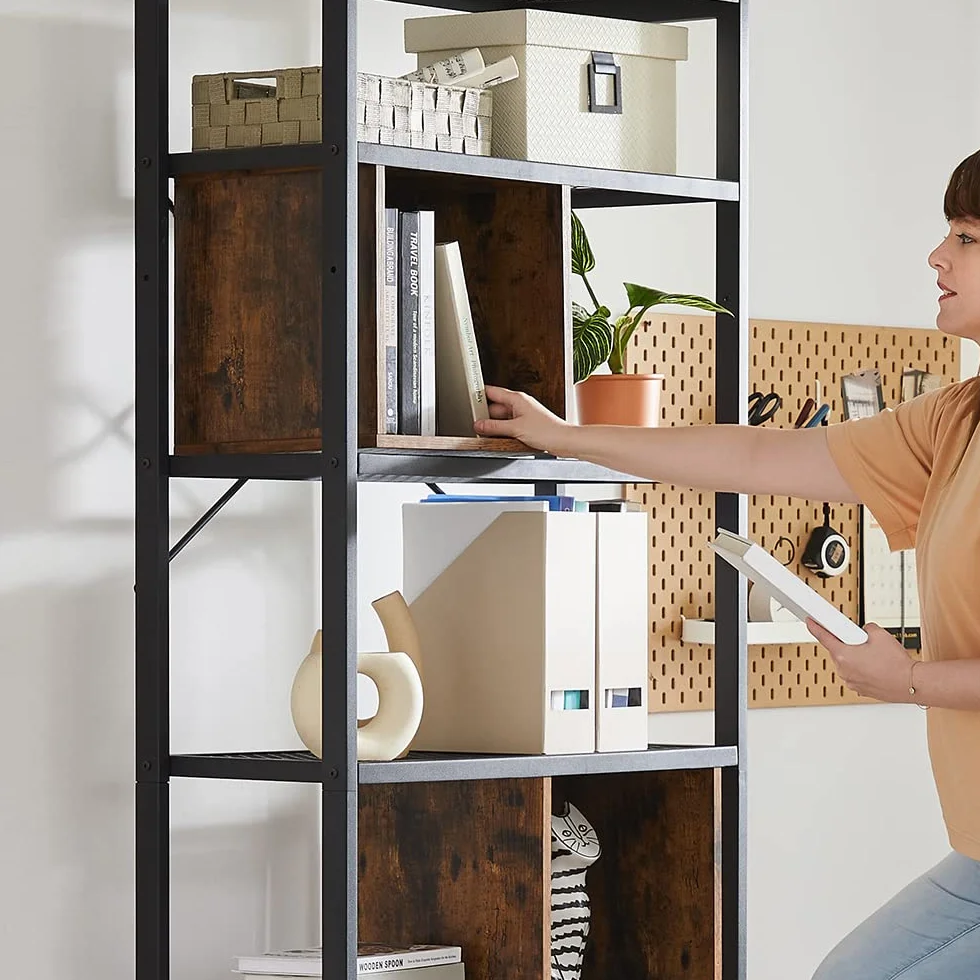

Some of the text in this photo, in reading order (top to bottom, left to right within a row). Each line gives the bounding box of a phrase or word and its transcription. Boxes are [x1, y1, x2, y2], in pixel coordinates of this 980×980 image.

[410, 232, 418, 297] TRAVEL BOOK
[359, 959, 404, 971] WOODEN SPOON
